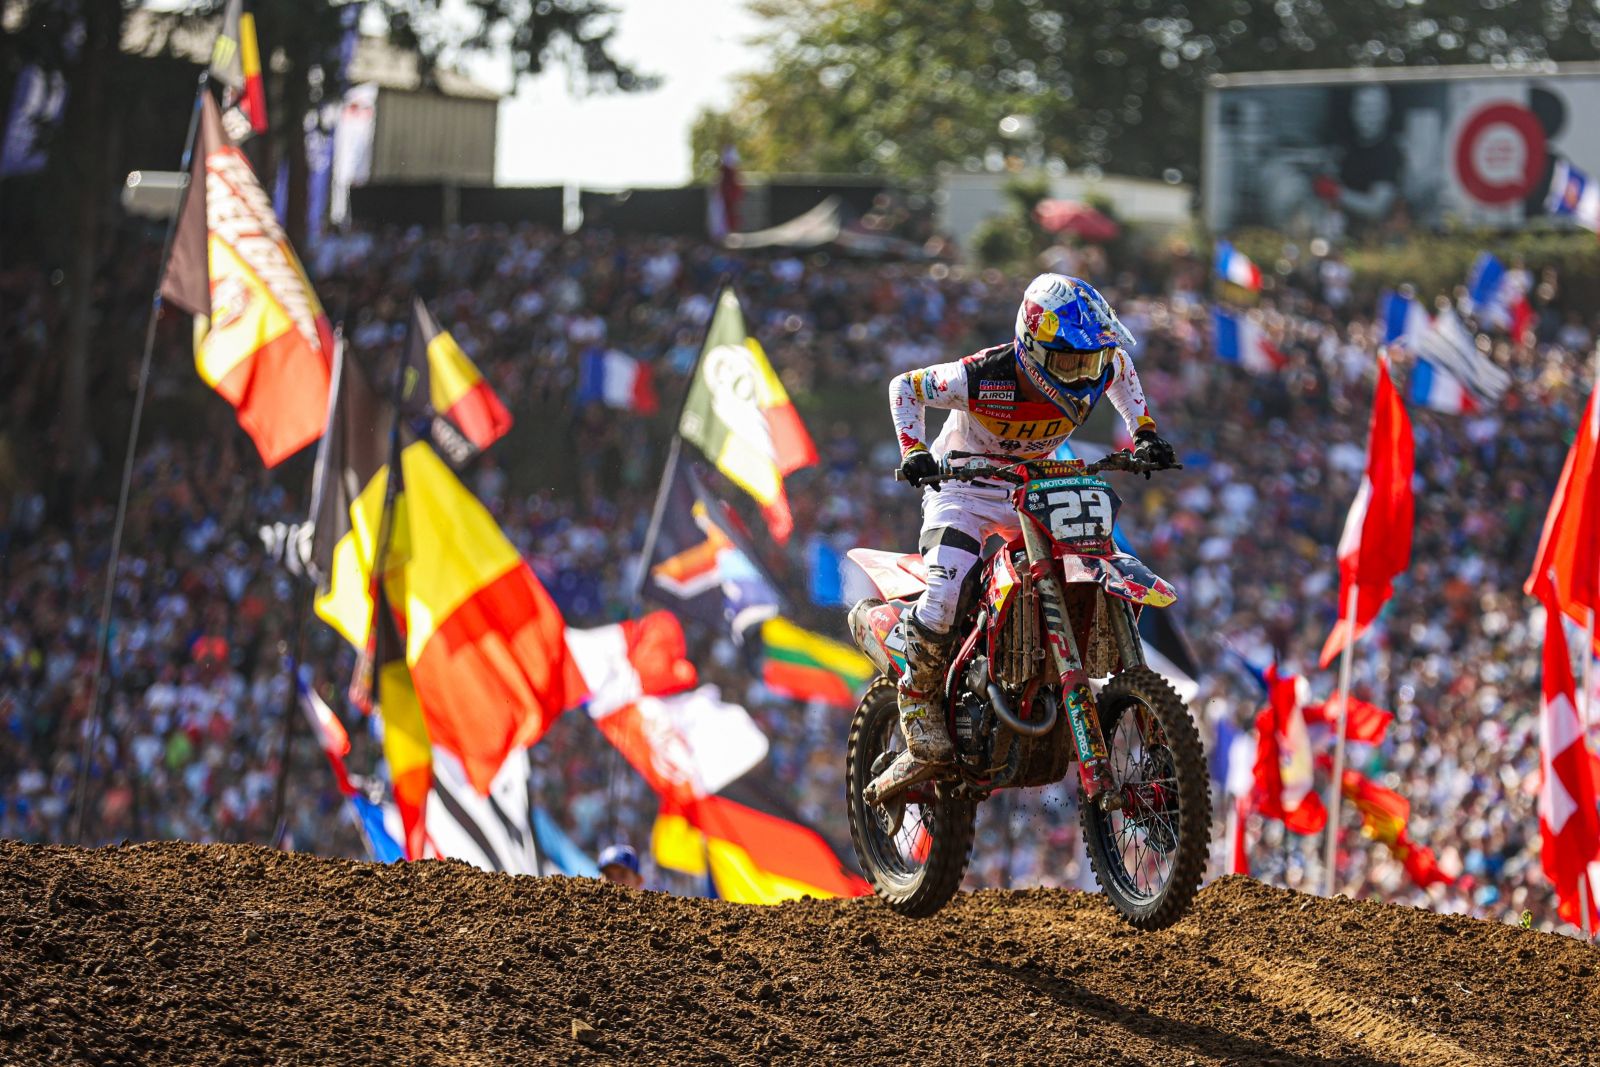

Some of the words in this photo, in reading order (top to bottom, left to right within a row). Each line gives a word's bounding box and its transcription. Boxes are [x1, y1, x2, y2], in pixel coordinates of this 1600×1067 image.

[981, 392, 1013, 400] AIROH
[985, 410, 1012, 419] DEKRA
[1040, 477, 1081, 488] MOTOREX
[1047, 490, 1112, 540] 23
[1070, 708, 1090, 756] MOTOREX
